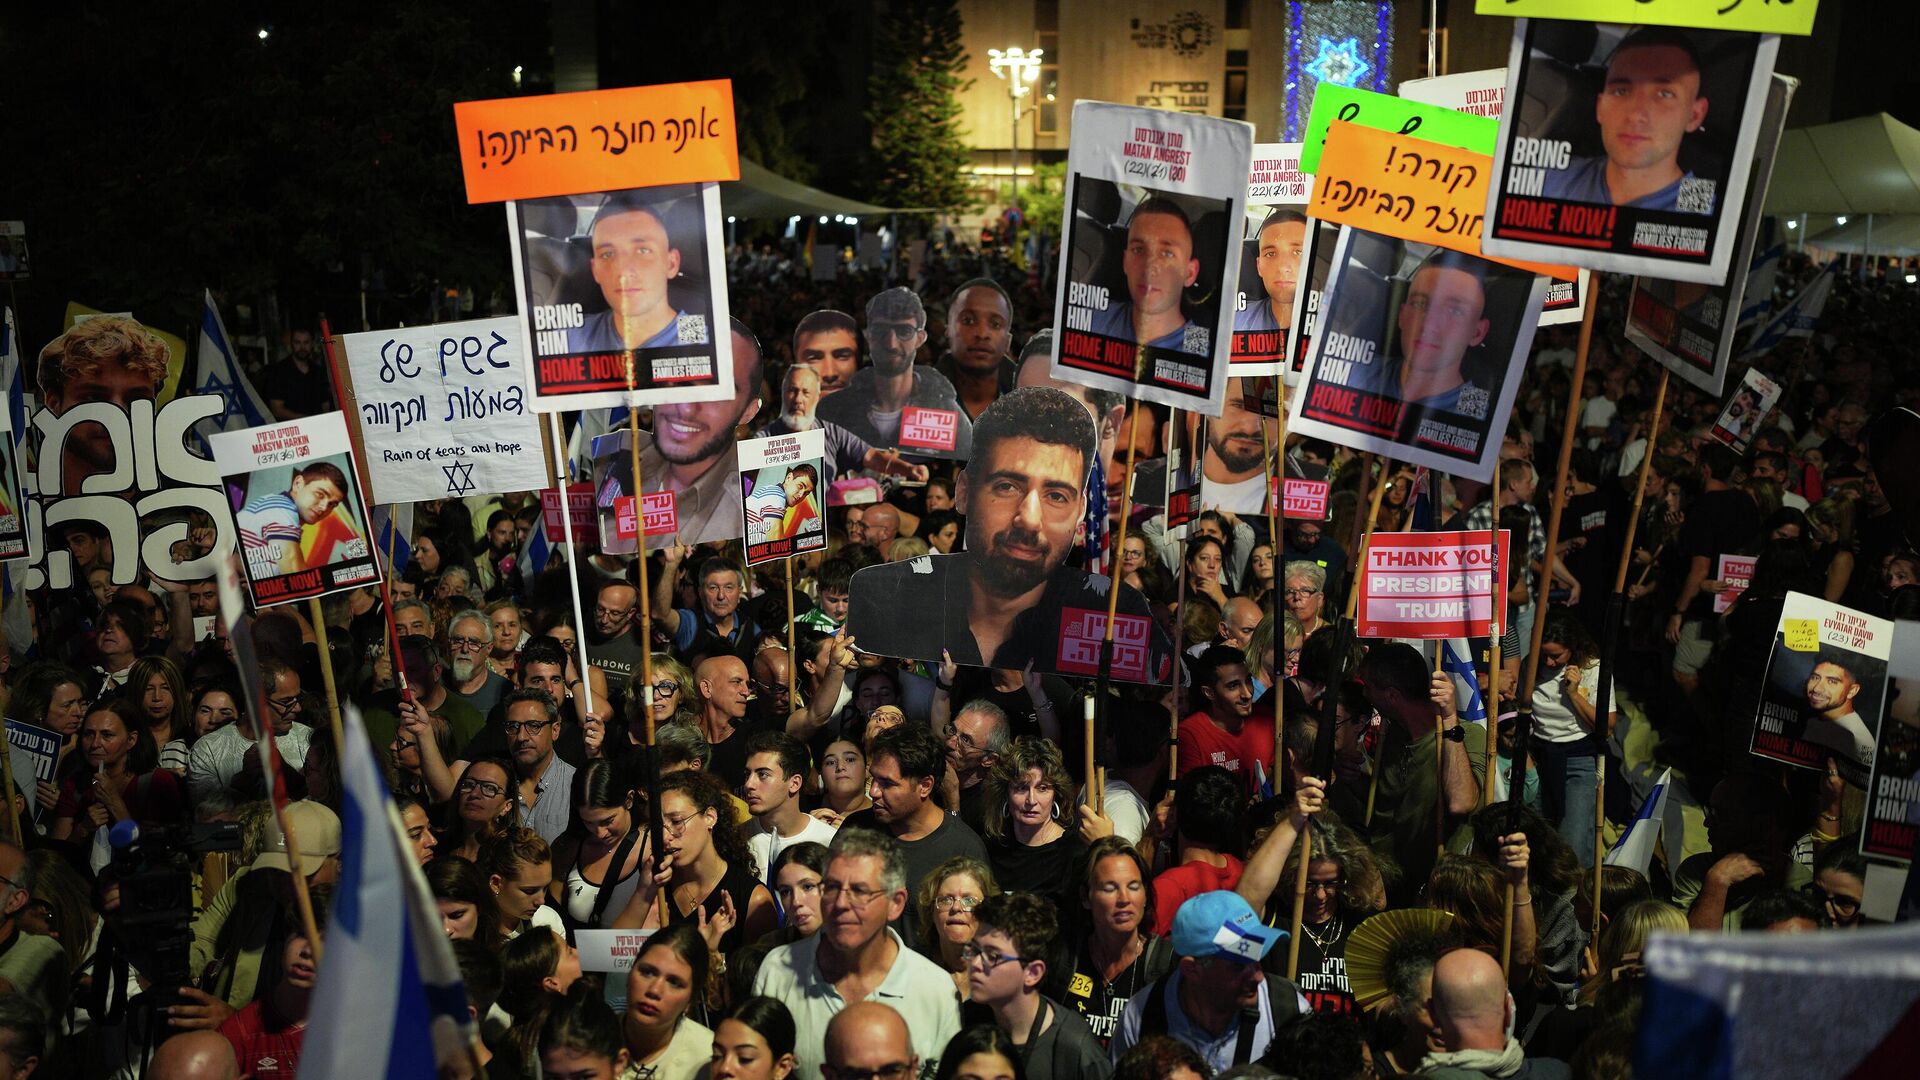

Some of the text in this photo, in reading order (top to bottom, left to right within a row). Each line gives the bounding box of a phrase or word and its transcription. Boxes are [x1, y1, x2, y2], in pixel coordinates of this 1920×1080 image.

[477, 106, 720, 170] אתה חוזר הביתה!
[1167, 132, 1183, 148] מתן
[1123, 142, 1192, 165] MATAN ANGREST
[1511, 136, 1572, 170] BRING
[1272, 171, 1307, 183] ANGREST
[1384, 145, 1478, 194] קורה!
[1506, 165, 1546, 198] HIM
[1320, 176, 1416, 223] הביתה!
[1501, 196, 1617, 239] HOME NOW!
[1633, 232, 1707, 253] FAMILIES FORUM
[1069, 280, 1110, 311] BRING
[1550, 289, 1573, 302] FORUM
[533, 302, 584, 331] BRING
[1066, 305, 1093, 332] HIM
[536, 328, 569, 357] HIM
[1063, 331, 1102, 360] HOME
[1247, 330, 1285, 354] NOW!
[1324, 331, 1376, 364] BRING
[379, 331, 511, 383] גשם של
[538, 355, 586, 384] HOME
[1317, 357, 1353, 386] HIM
[362, 385, 524, 433] דמעות ותקווה
[1310, 383, 1406, 429] HOME NOW!
[918, 412, 953, 426] עדיין
[252, 434, 310, 455] MAKSYM HARKIN
[383, 449, 413, 463] Rain
[434, 445, 466, 457] tears
[471, 443, 491, 454] and
[494, 441, 522, 456] hope
[1450, 434, 1478, 452] FORUM
[1286, 481, 1326, 496] עדיין
[748, 521, 771, 535] BRING
[748, 533, 765, 546] HIM
[246, 544, 282, 565] BRING
[748, 543, 769, 559] HOME
[770, 538, 791, 554] NOW!
[1372, 550, 1448, 567] THANK
[1453, 549, 1492, 566] YOU
[250, 562, 274, 581] HIM
[256, 577, 289, 598] HOME
[289, 568, 323, 590] NOW!
[1371, 574, 1492, 593] PRESIDENT
[1395, 602, 1471, 619] TRUMP
[1824, 617, 1853, 635] EVYATAR
[1853, 627, 1874, 641] DAVID
[1827, 630, 1849, 644] (23)
[1763, 700, 1799, 724] BRING
[1760, 715, 1784, 735] HIM
[42, 737, 56, 754] עד
[1757, 731, 1790, 753] HOME
[1878, 774, 1920, 803] BRIN
[1873, 796, 1908, 823] HIM
[610, 946, 638, 957] MAKSYM
